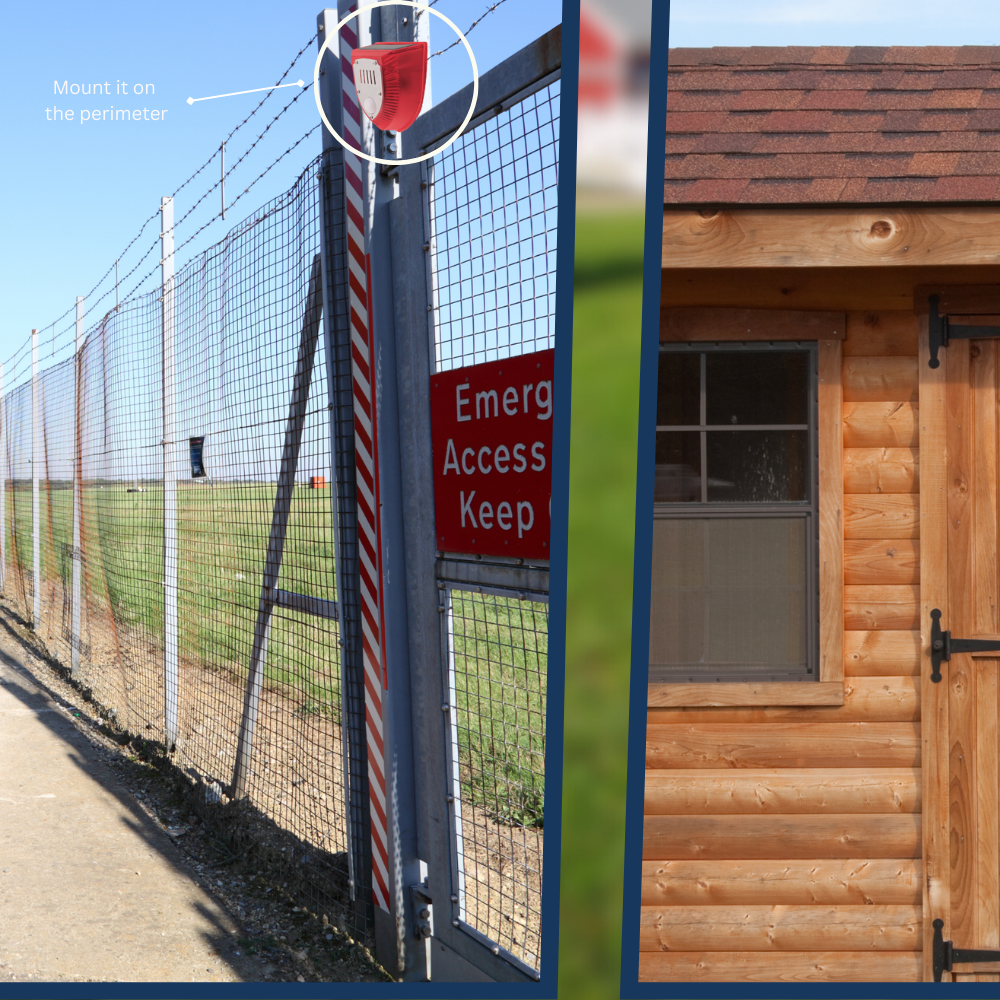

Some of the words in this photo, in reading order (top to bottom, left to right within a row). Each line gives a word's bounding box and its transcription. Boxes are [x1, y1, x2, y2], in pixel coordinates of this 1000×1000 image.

[456, 380, 553, 422] Emerg
[443, 438, 546, 476] Access
[460, 490, 534, 539] Keep
